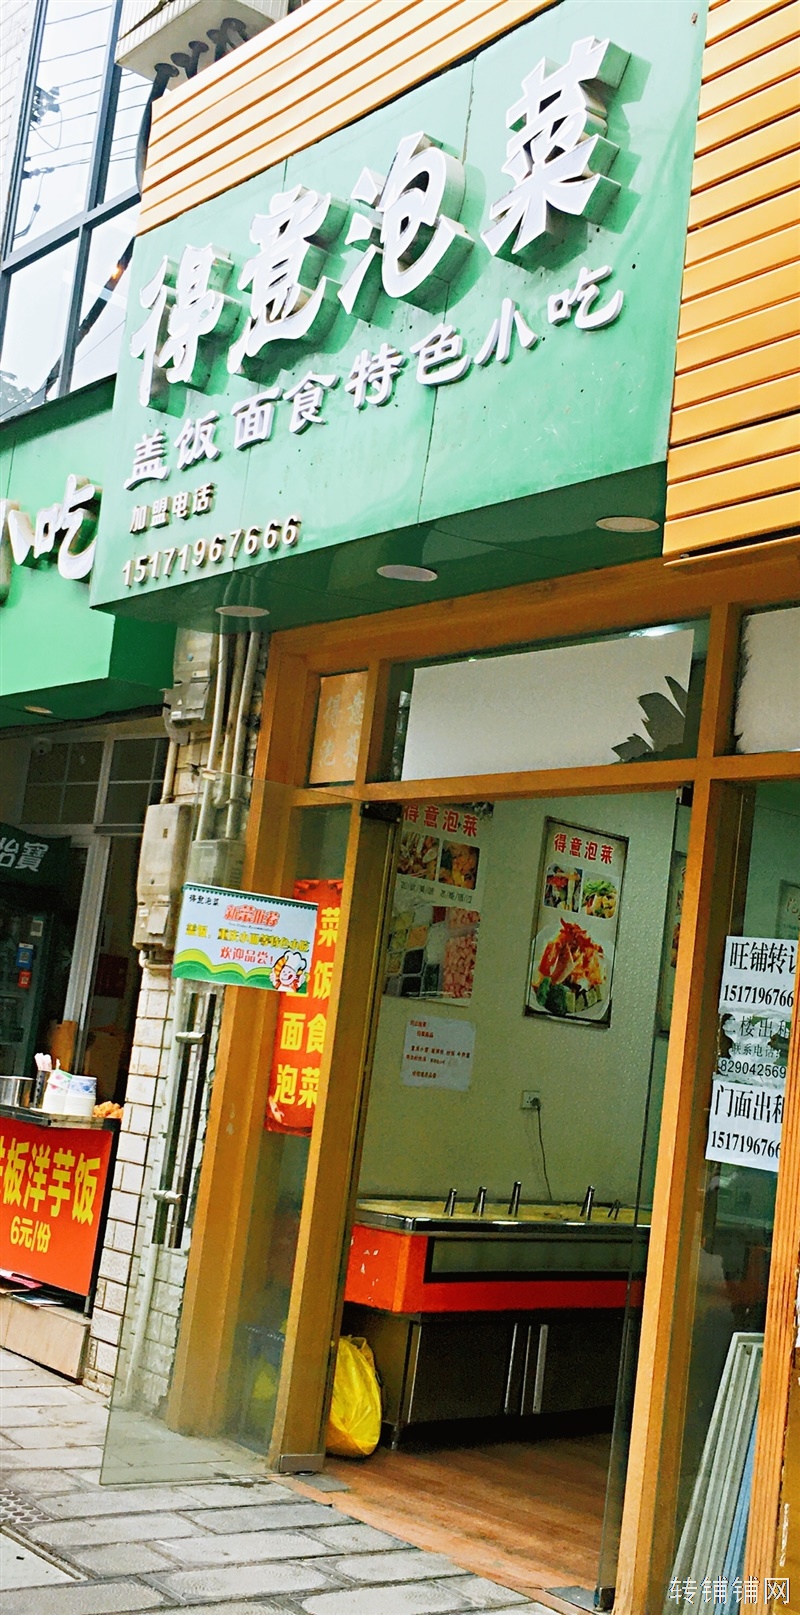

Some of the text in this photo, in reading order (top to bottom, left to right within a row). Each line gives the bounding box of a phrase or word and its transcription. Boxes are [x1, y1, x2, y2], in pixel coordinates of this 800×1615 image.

[129, 36, 622, 407] 得意泡菜
[124, 265, 624, 491] 盖饭面食特色小吃
[129, 482, 215, 535] 加盟电话
[122, 514, 301, 588] 15171967666
[403, 804, 478, 838] 得意泡菜
[554, 832, 614, 865] 得意泡菜
[285, 960, 334, 1001] 饭
[723, 984, 795, 1008] 1517196766
[280, 1012, 328, 1054] 面食
[273, 1063, 321, 1109] 泡菜
[0, 1135, 101, 1226] 板洋芋饭
[10, 1215, 52, 1253] 6元/份
